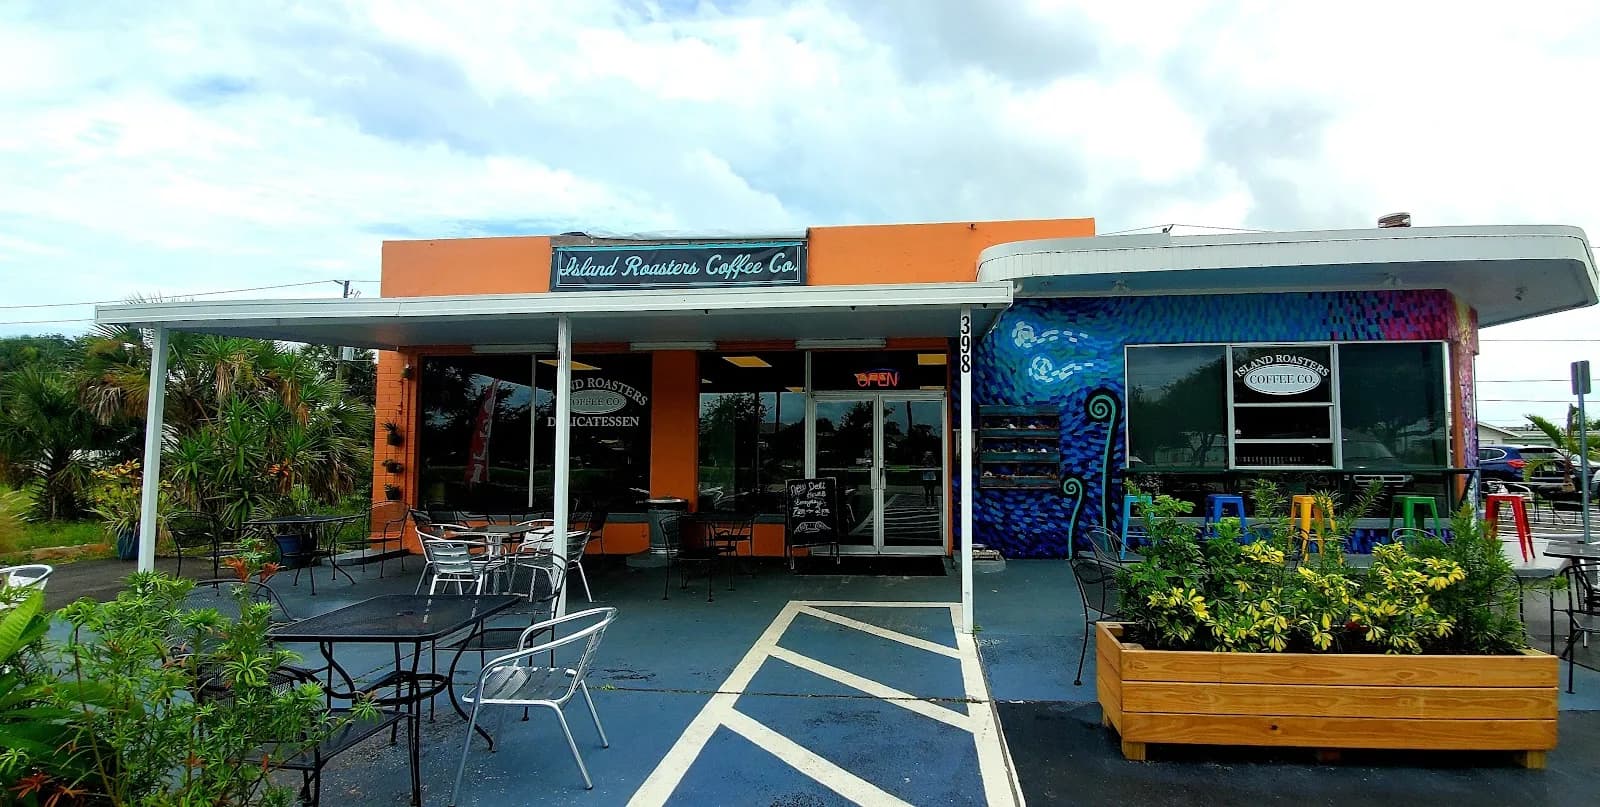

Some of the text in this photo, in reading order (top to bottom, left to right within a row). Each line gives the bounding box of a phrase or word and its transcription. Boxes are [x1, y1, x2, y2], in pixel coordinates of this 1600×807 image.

[560, 252, 798, 280] Island Roasters Coffee Co.
[961, 316, 971, 373] 398
[1234, 354, 1330, 378] ISLAND ROASTERS
[856, 371, 898, 387] OPEN
[1249, 374, 1315, 384] COFFEE CO.
[587, 377, 648, 406] ROASTERS
[570, 398, 603, 406] OFFEE
[546, 416, 641, 427] DICATESSEN
